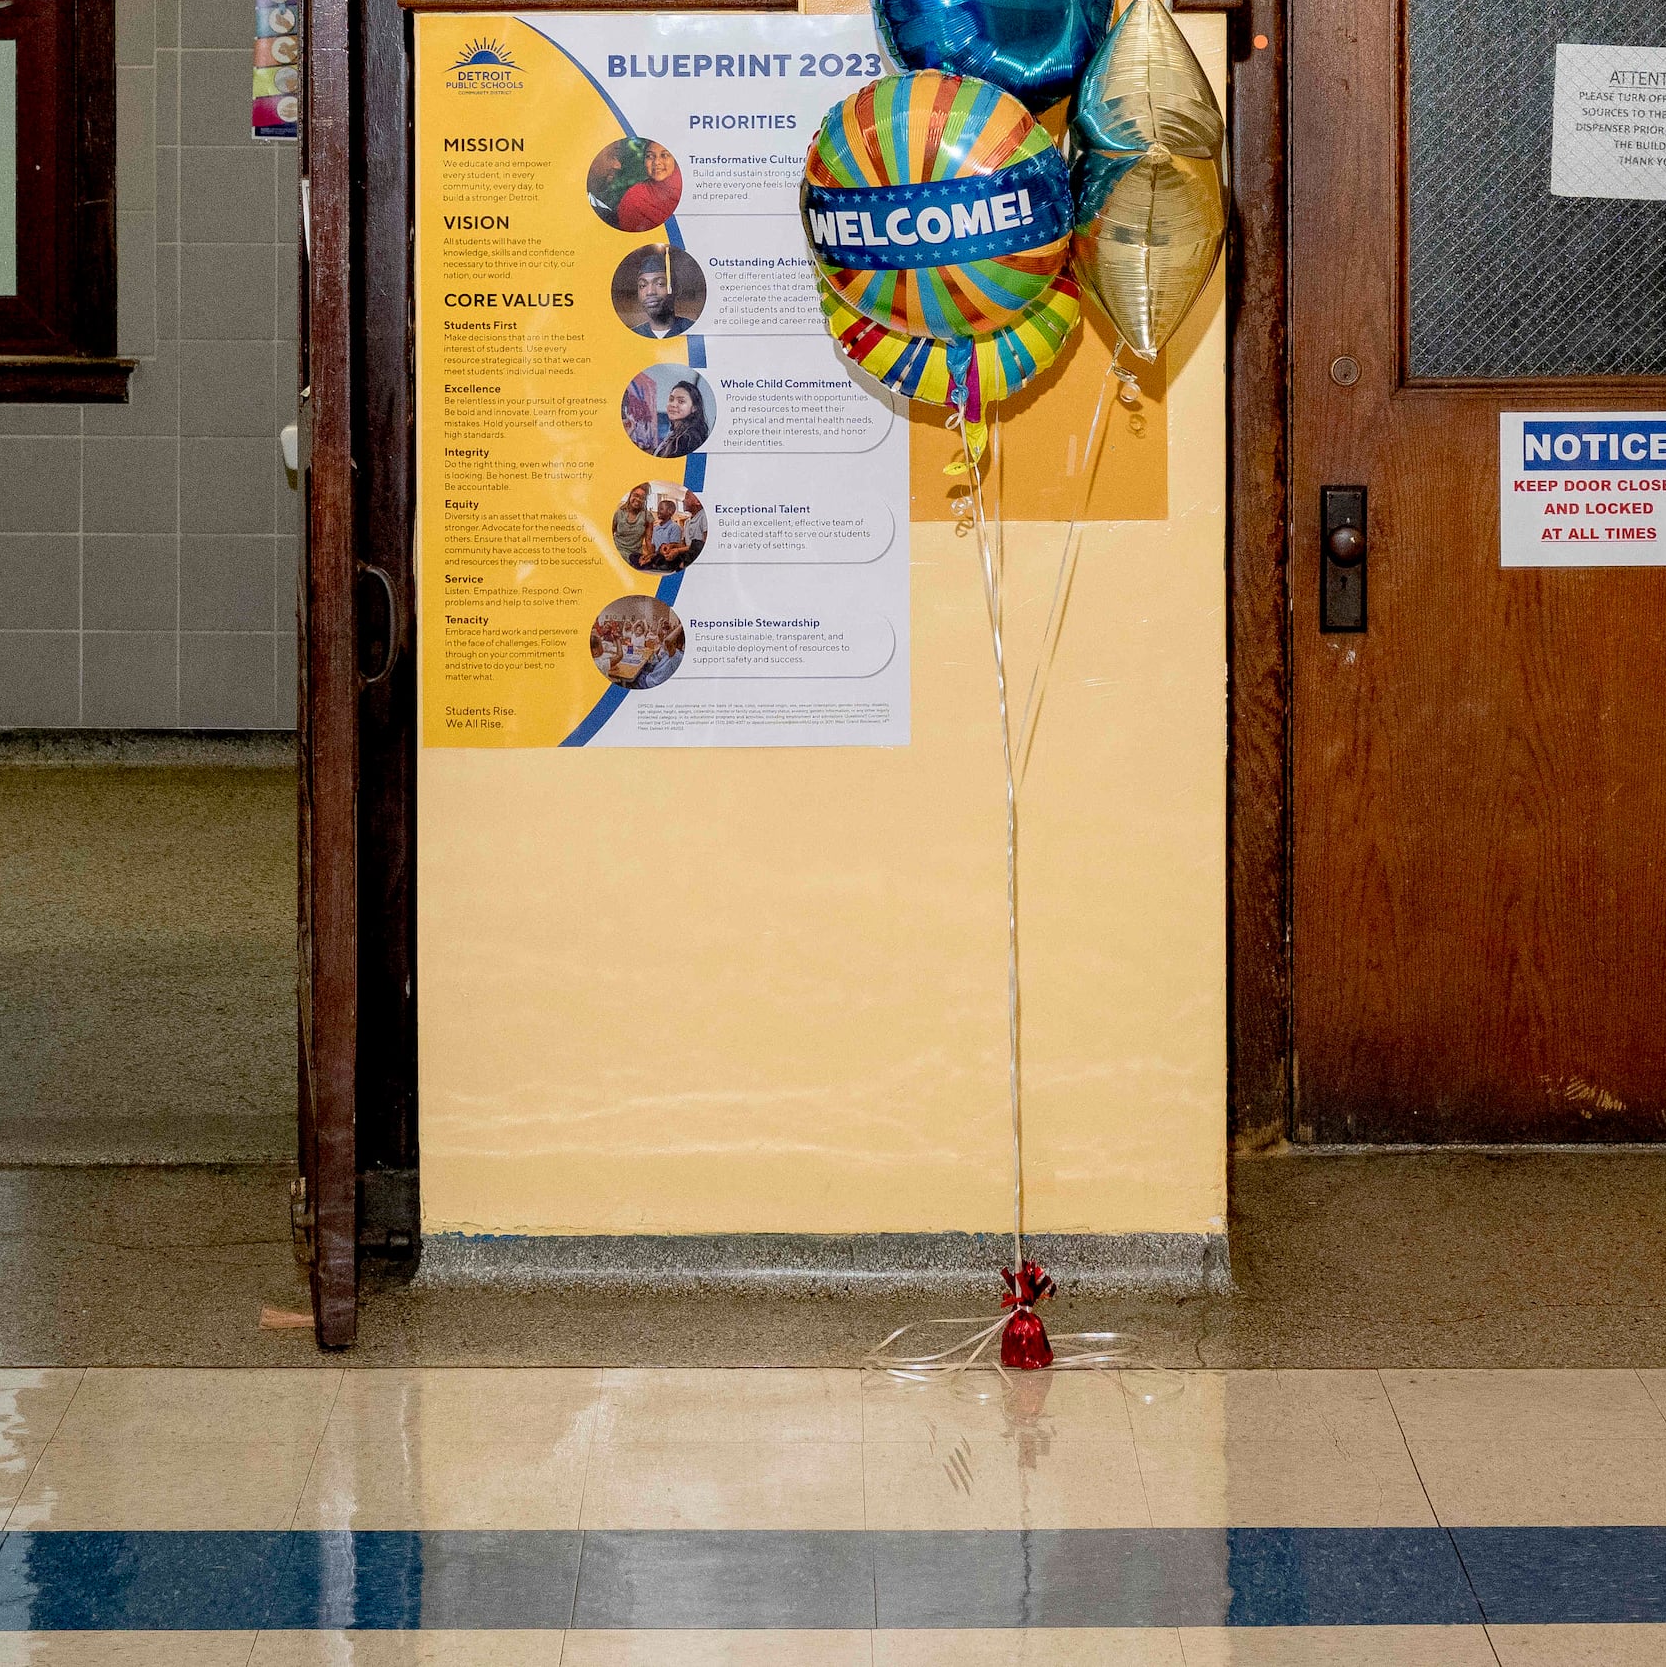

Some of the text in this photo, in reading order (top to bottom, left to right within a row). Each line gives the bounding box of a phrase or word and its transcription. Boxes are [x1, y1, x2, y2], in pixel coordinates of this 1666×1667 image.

[608, 54, 882, 77] BLUEPRINT 2023
[458, 72, 511, 80] DETROIT
[1579, 91, 1614, 101] PLEASE
[1618, 93, 1646, 102] TURN
[1582, 108, 1629, 117] SOURCES
[1632, 109, 1645, 118] TO
[1649, 109, 1666, 118] THE
[690, 115, 796, 129] PRIORITIES
[1576, 123, 1631, 133] DISPENSER
[1633, 125, 1664, 134] PRIOR
[444, 138, 524, 152] MISSION
[1614, 140, 1632, 149] THE
[689, 155, 767, 164] Transformative
[1619, 156, 1653, 165] THANK
[444, 216, 509, 229] VISION
[810, 189, 1035, 248] WELCOME!
[709, 258, 775, 269] Outstanding
[444, 293, 574, 307] CORE VALUES
[444, 321, 517, 330] Students First
[444, 384, 501, 393] Excellence
[720, 378, 852, 389] Whole Child Commitment
[445, 448, 489, 459] Integrity
[1514, 480, 1558, 491] KEEP
[1564, 480, 1611, 491] DOOR
[445, 500, 479, 511] Equity
[715, 504, 810, 515] Exceptional Talent
[1544, 503, 1653, 514] AND LOCKED
[1542, 528, 1656, 542] AT ALL TIMES
[445, 574, 483, 583] Service
[445, 615, 488, 626] Tenacity
[690, 618, 820, 629] Responsible Stewardship
[446, 706, 514, 716] Students Rise.
[446, 716, 501, 728] We All Rise.
